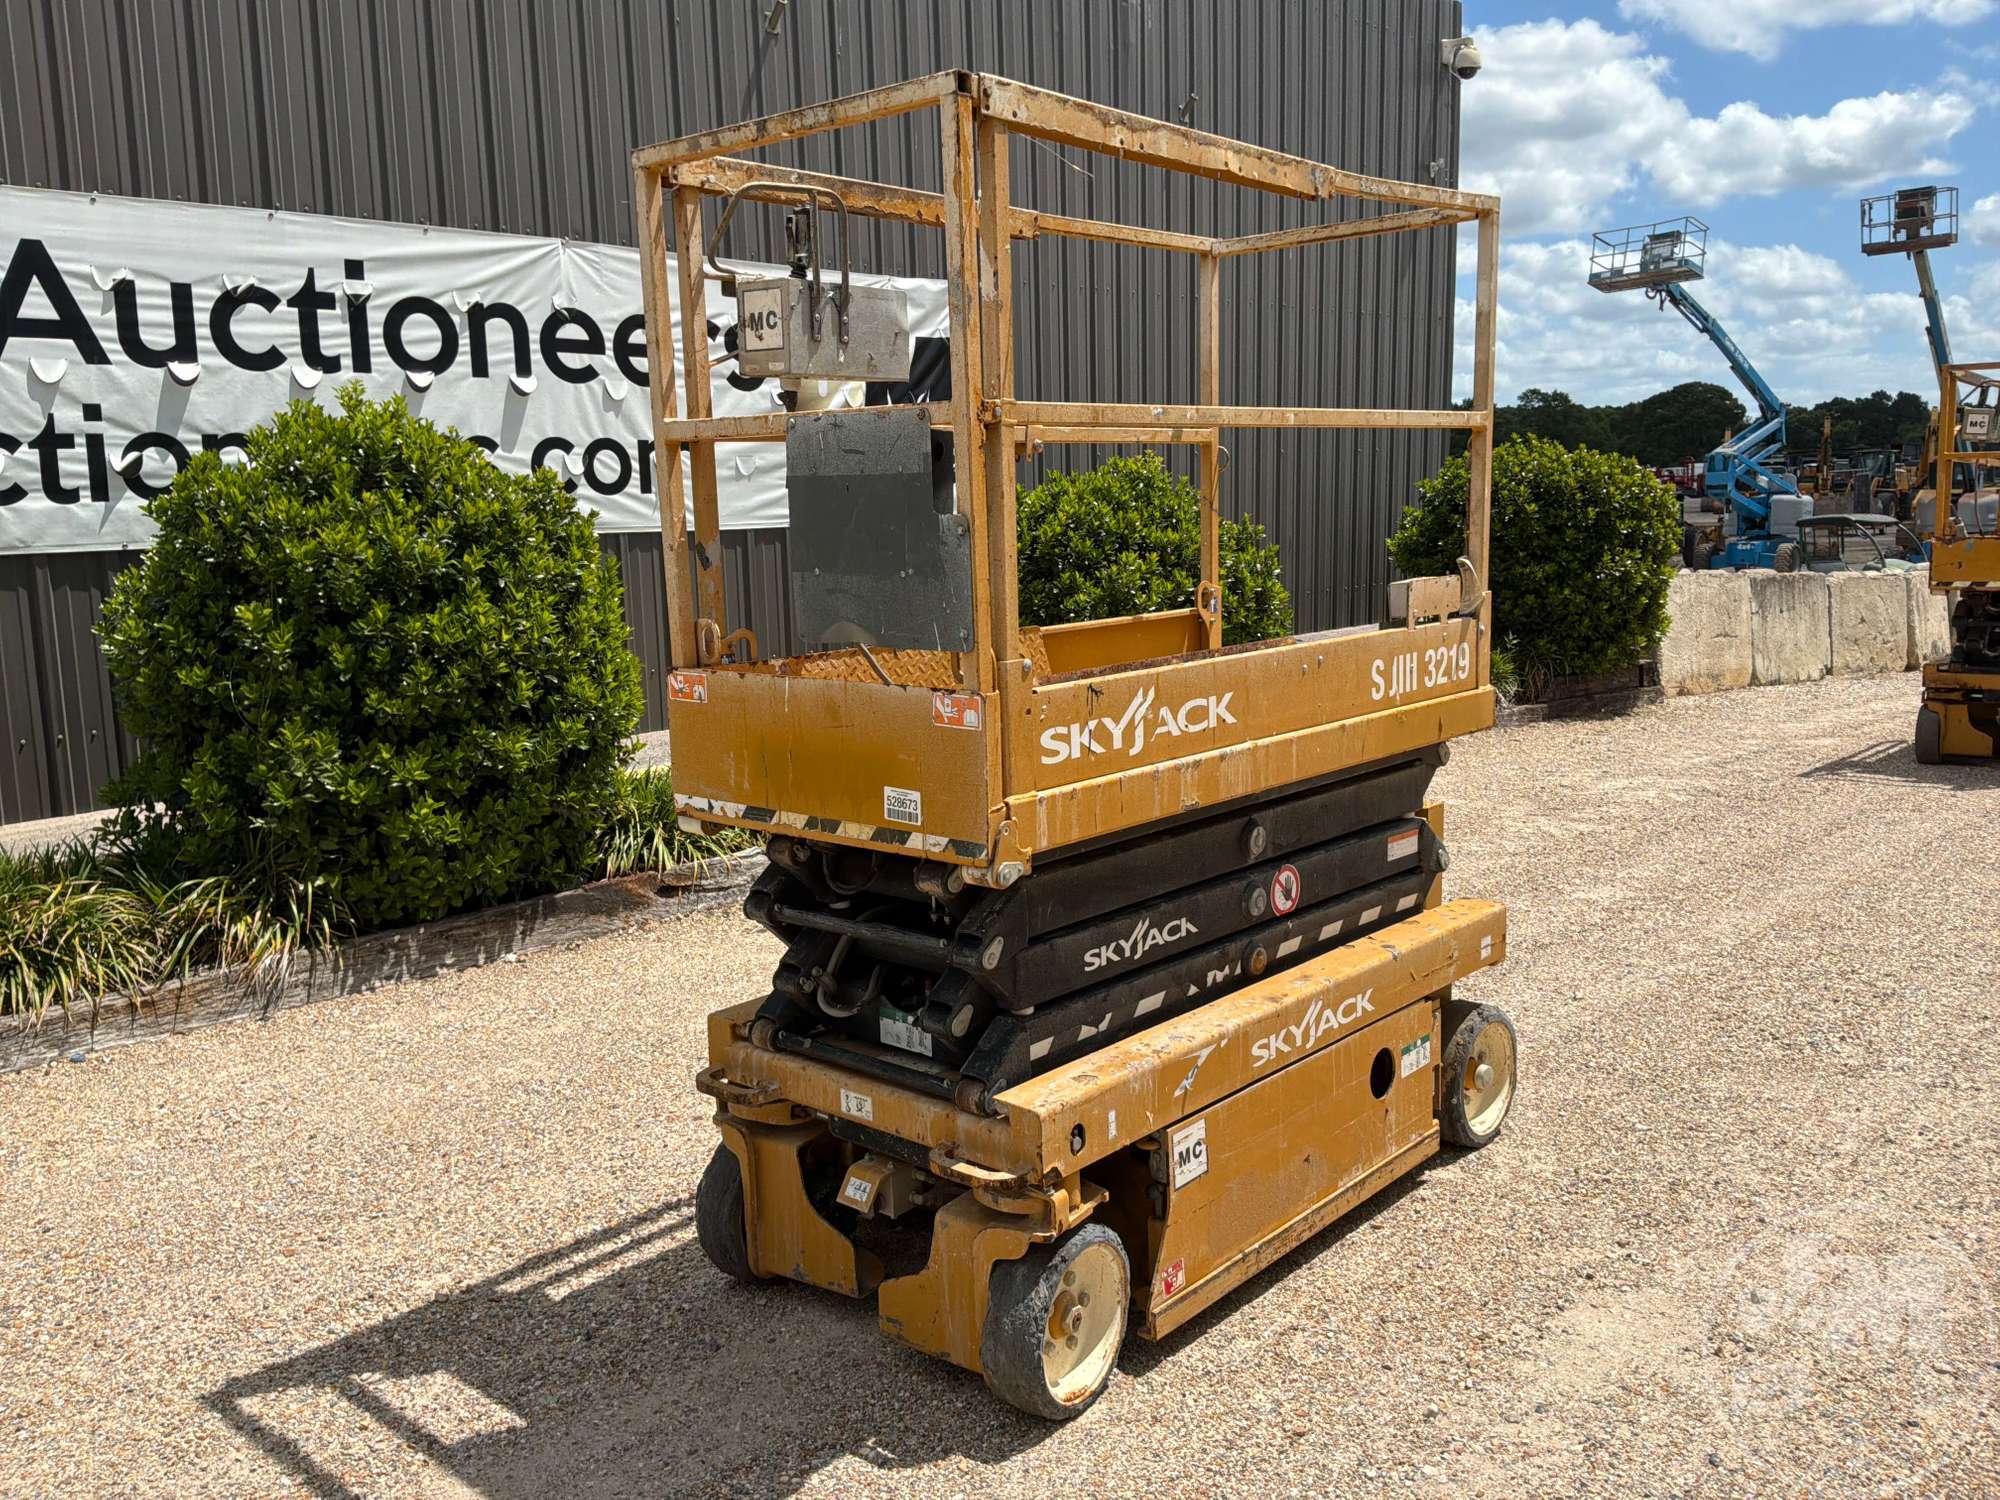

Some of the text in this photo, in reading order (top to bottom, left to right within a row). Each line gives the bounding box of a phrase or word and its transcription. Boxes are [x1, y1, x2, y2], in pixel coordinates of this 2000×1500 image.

[0, 238, 764, 391] Auctionee
[750, 311, 778, 331] MC
[1424, 641, 1470, 688] 3219
[1039, 685, 1238, 765] SKYJACK
[886, 794, 918, 812] 528673
[1083, 916, 1199, 972] SKYJACK
[1251, 987, 1376, 1068] SKYJACK
[1178, 1140, 1203, 1169] MC
